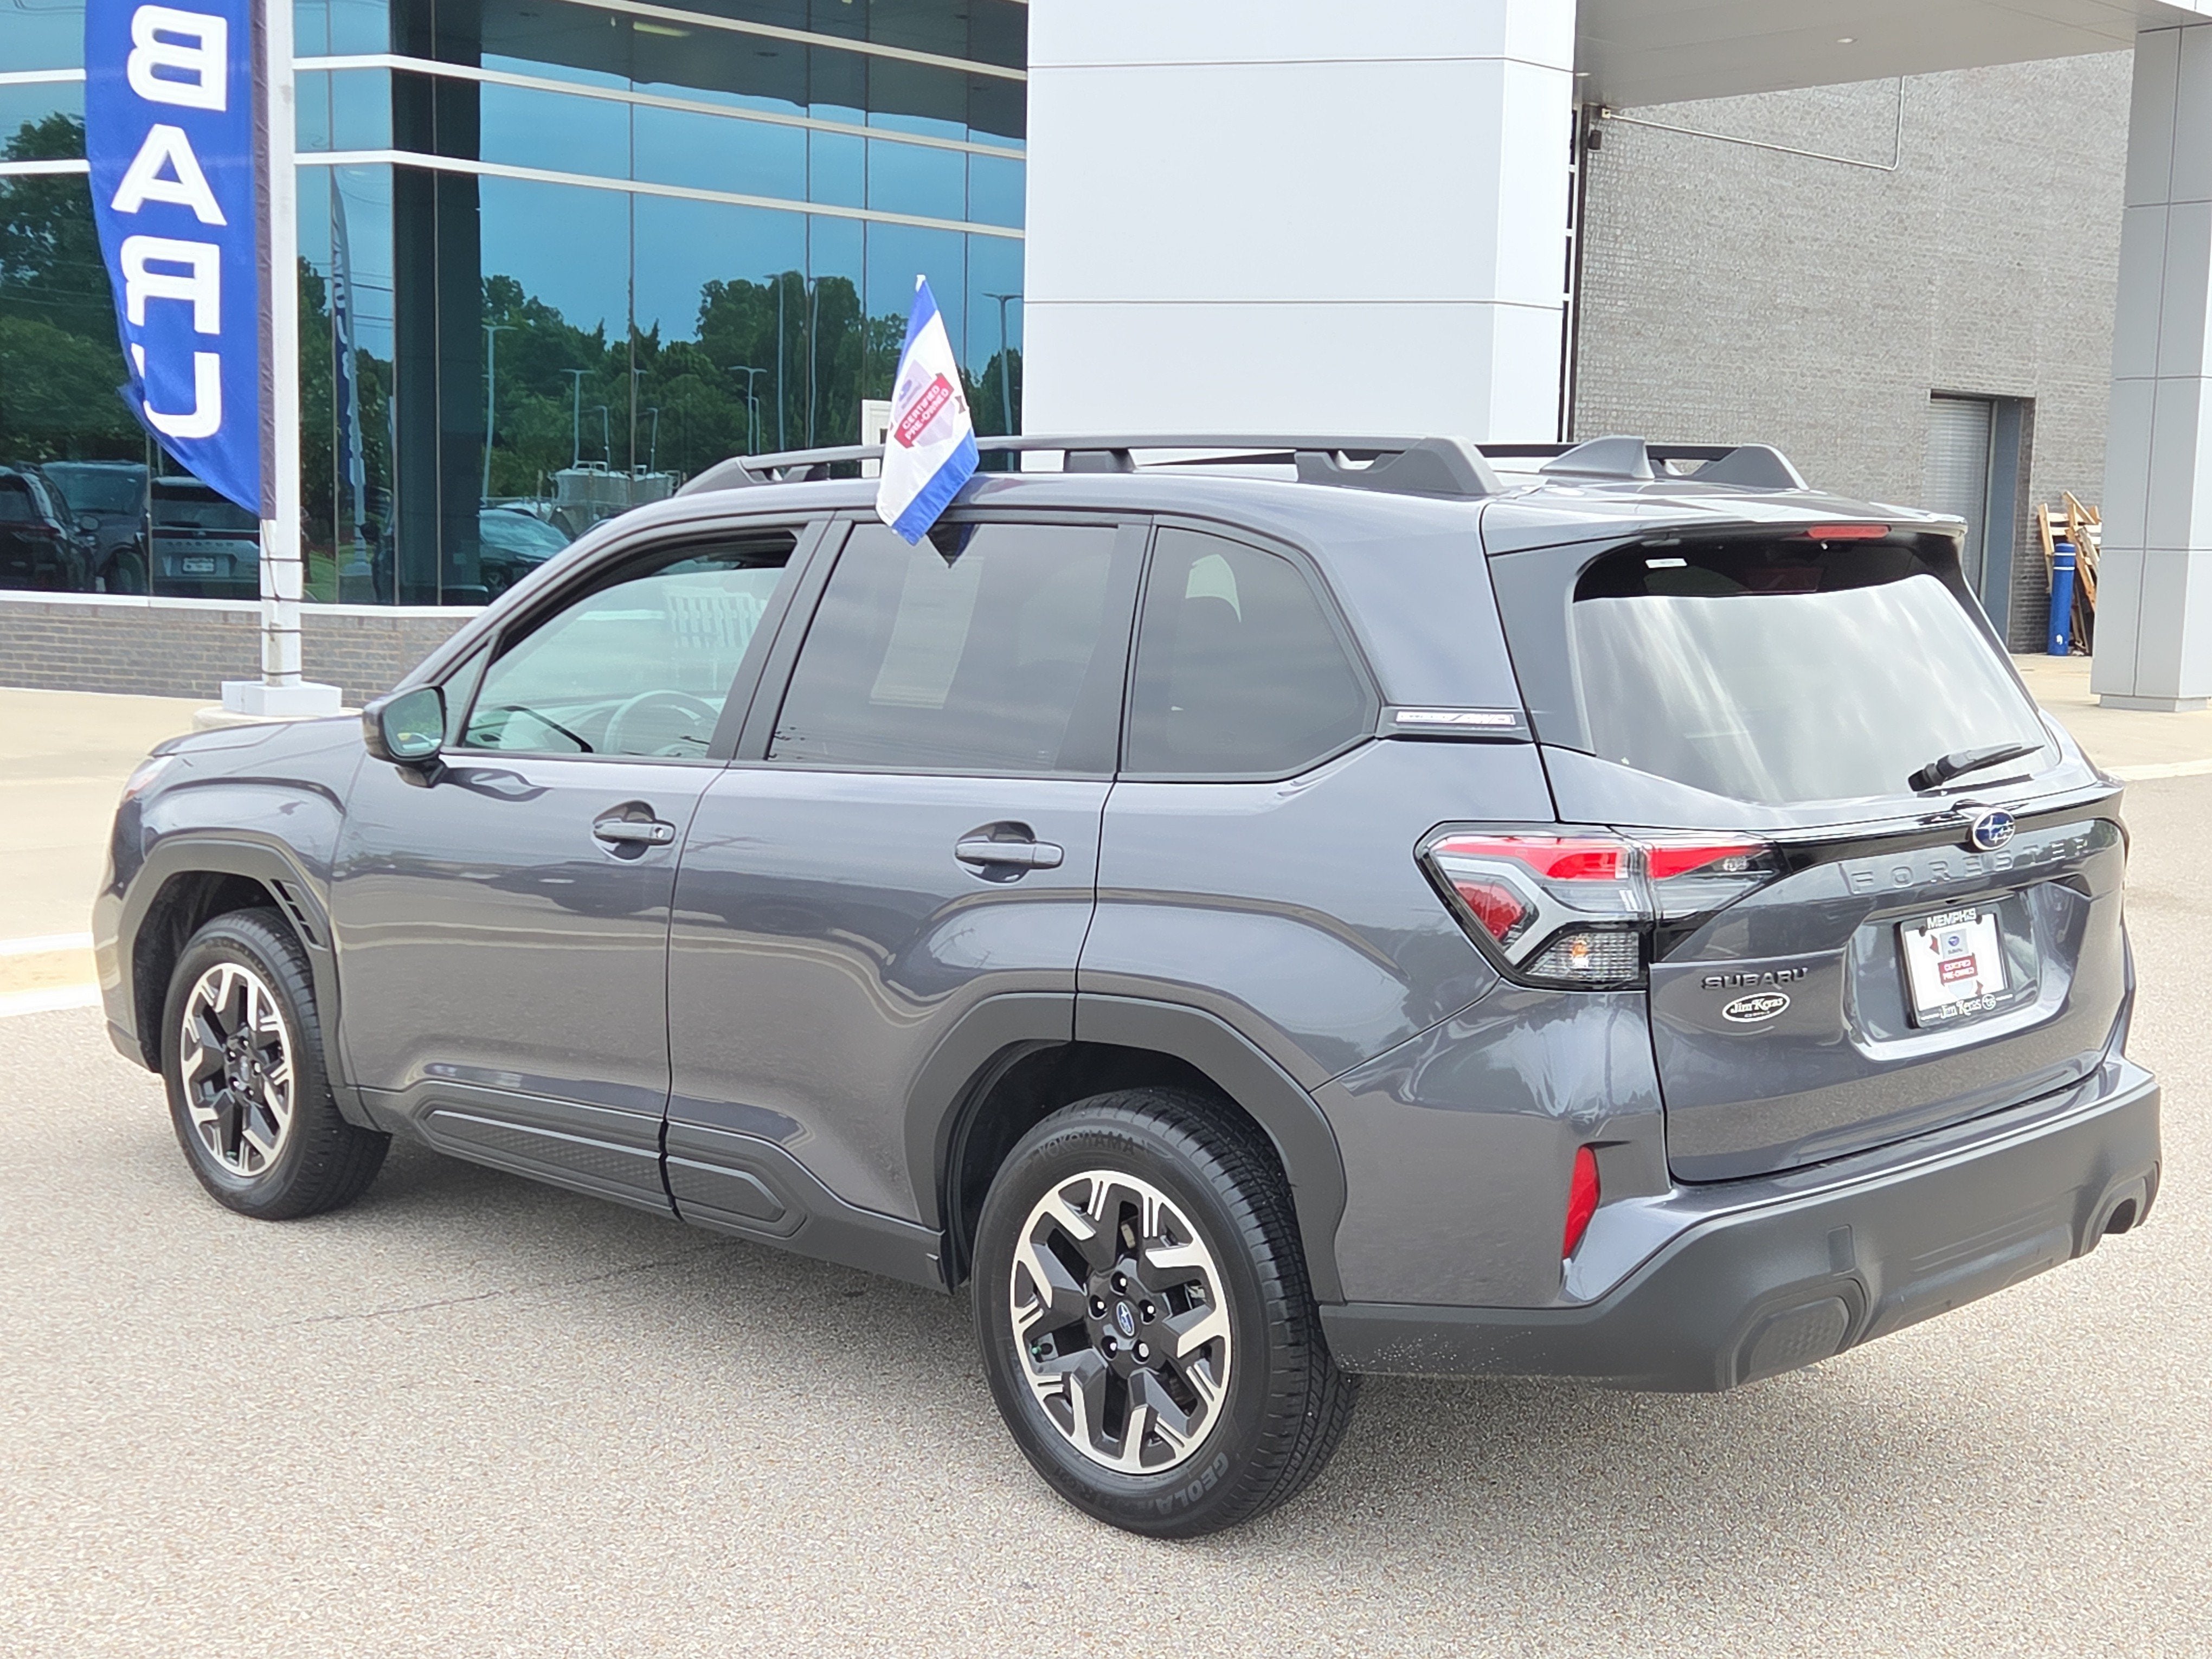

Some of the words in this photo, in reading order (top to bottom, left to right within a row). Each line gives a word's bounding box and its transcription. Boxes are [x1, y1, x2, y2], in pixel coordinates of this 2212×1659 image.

[902, 384, 941, 430] CERTIFIED
[904, 388, 949, 440] PRE-OWNED
[1851, 838, 2088, 895] FORESTER
[1926, 908, 1977, 929] MEMPHIS
[1701, 967, 1809, 991] SUBARU
[1730, 1002, 1752, 1014] Jim
